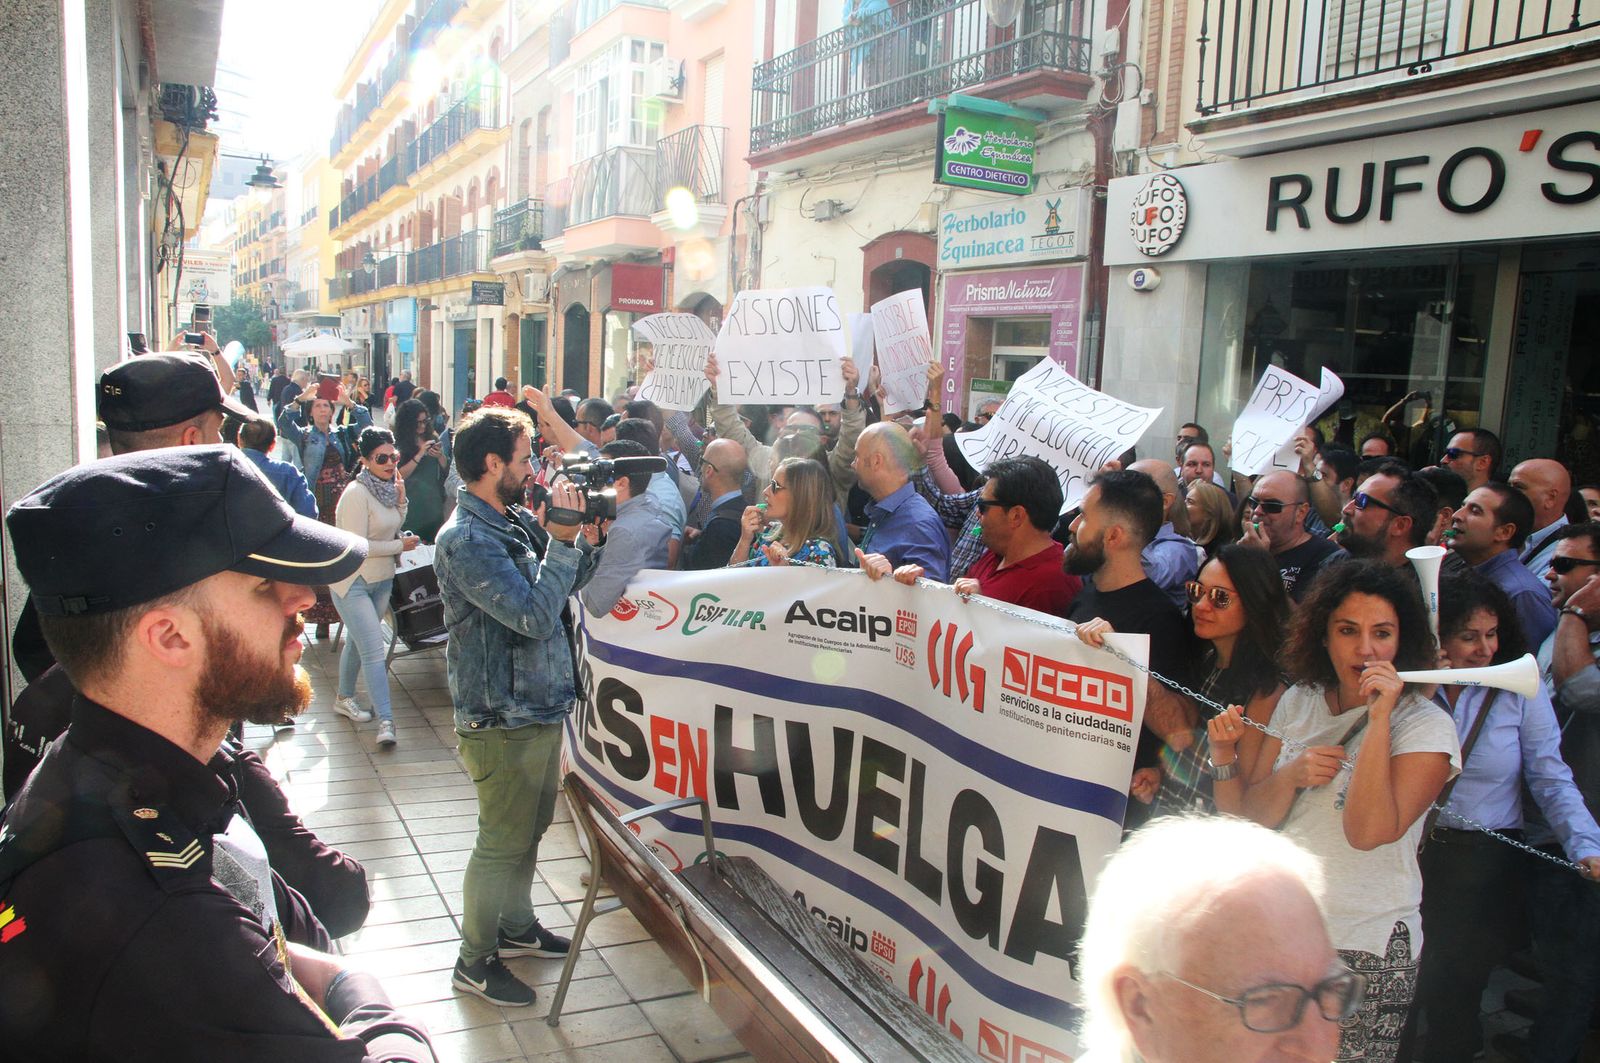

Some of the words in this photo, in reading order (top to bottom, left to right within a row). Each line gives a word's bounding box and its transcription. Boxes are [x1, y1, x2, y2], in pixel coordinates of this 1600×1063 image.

[983, 130, 1034, 149] Herbolario
[950, 164, 984, 178] CENTRO
[985, 170, 1026, 185] DIETETICO
[1265, 128, 1600, 232] RUFO'S
[942, 207, 1027, 234] Herbolario
[941, 236, 1025, 263] Equinacea
[1030, 234, 1075, 250] TEGOR
[618, 297, 655, 306] PRONOVIAS
[727, 359, 833, 397] EXISTE
[1023, 367, 1149, 435] NECESITO
[694, 604, 728, 623] CSIF
[784, 600, 893, 642] Acaip
[898, 618, 916, 635] EPSU
[824, 638, 842, 647] Cuerpos
[856, 643, 891, 653] Administración
[1036, 664, 1128, 713] CCOO
[1000, 692, 1040, 714] servicios
[1042, 707, 1049, 717] a
[1052, 707, 1062, 721] la
[1065, 712, 1132, 738] ciudadanía
[999, 706, 1045, 730] instituciones
[1046, 723, 1115, 748] penitenciarias
[1116, 740, 1131, 753] sae
[650, 714, 709, 804] EN
[713, 703, 1088, 981] HUELGA
[873, 940, 894, 960] EPSU
